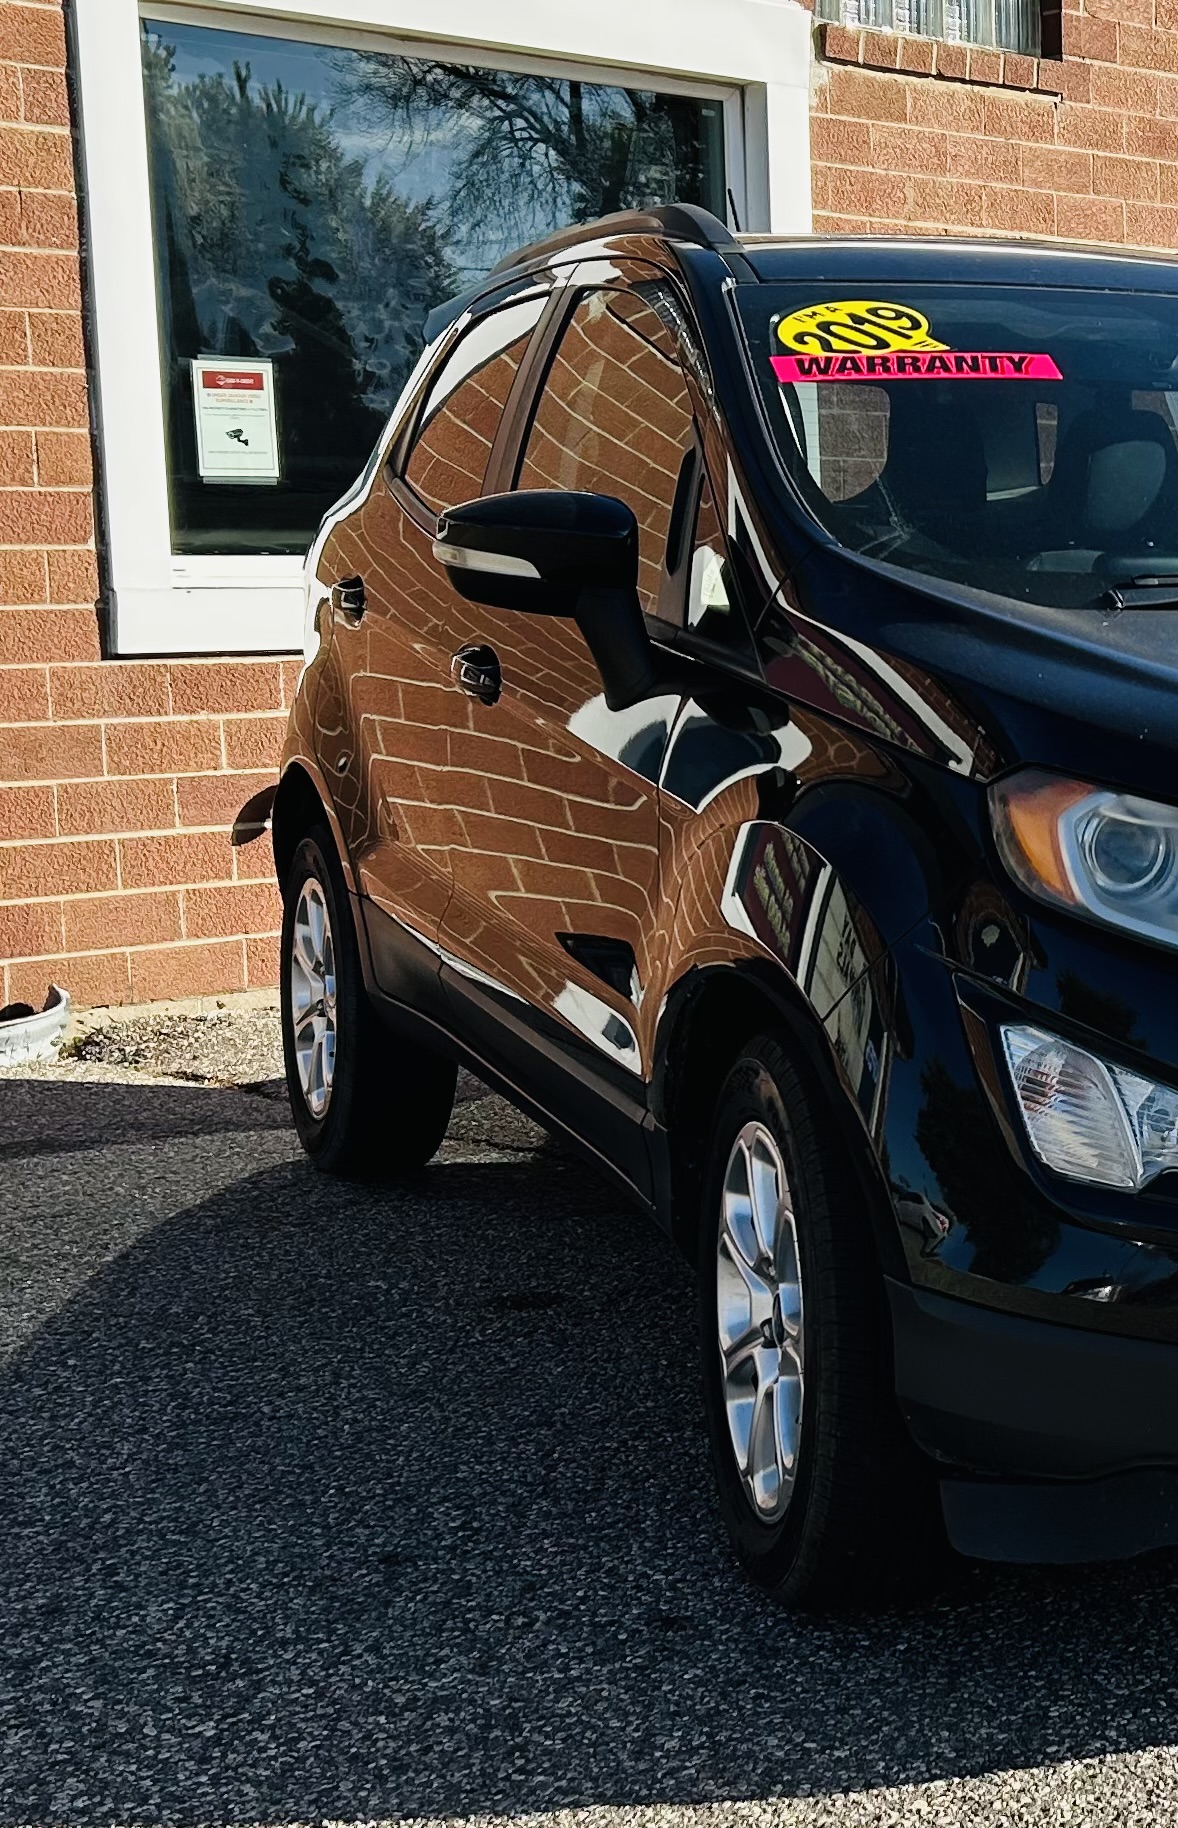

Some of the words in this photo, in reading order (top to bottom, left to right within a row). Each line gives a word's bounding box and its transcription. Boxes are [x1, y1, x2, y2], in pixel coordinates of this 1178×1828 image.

[792, 310, 825, 323] I'M
[792, 306, 923, 354] 2019
[794, 355, 1030, 376] WARRANTY
